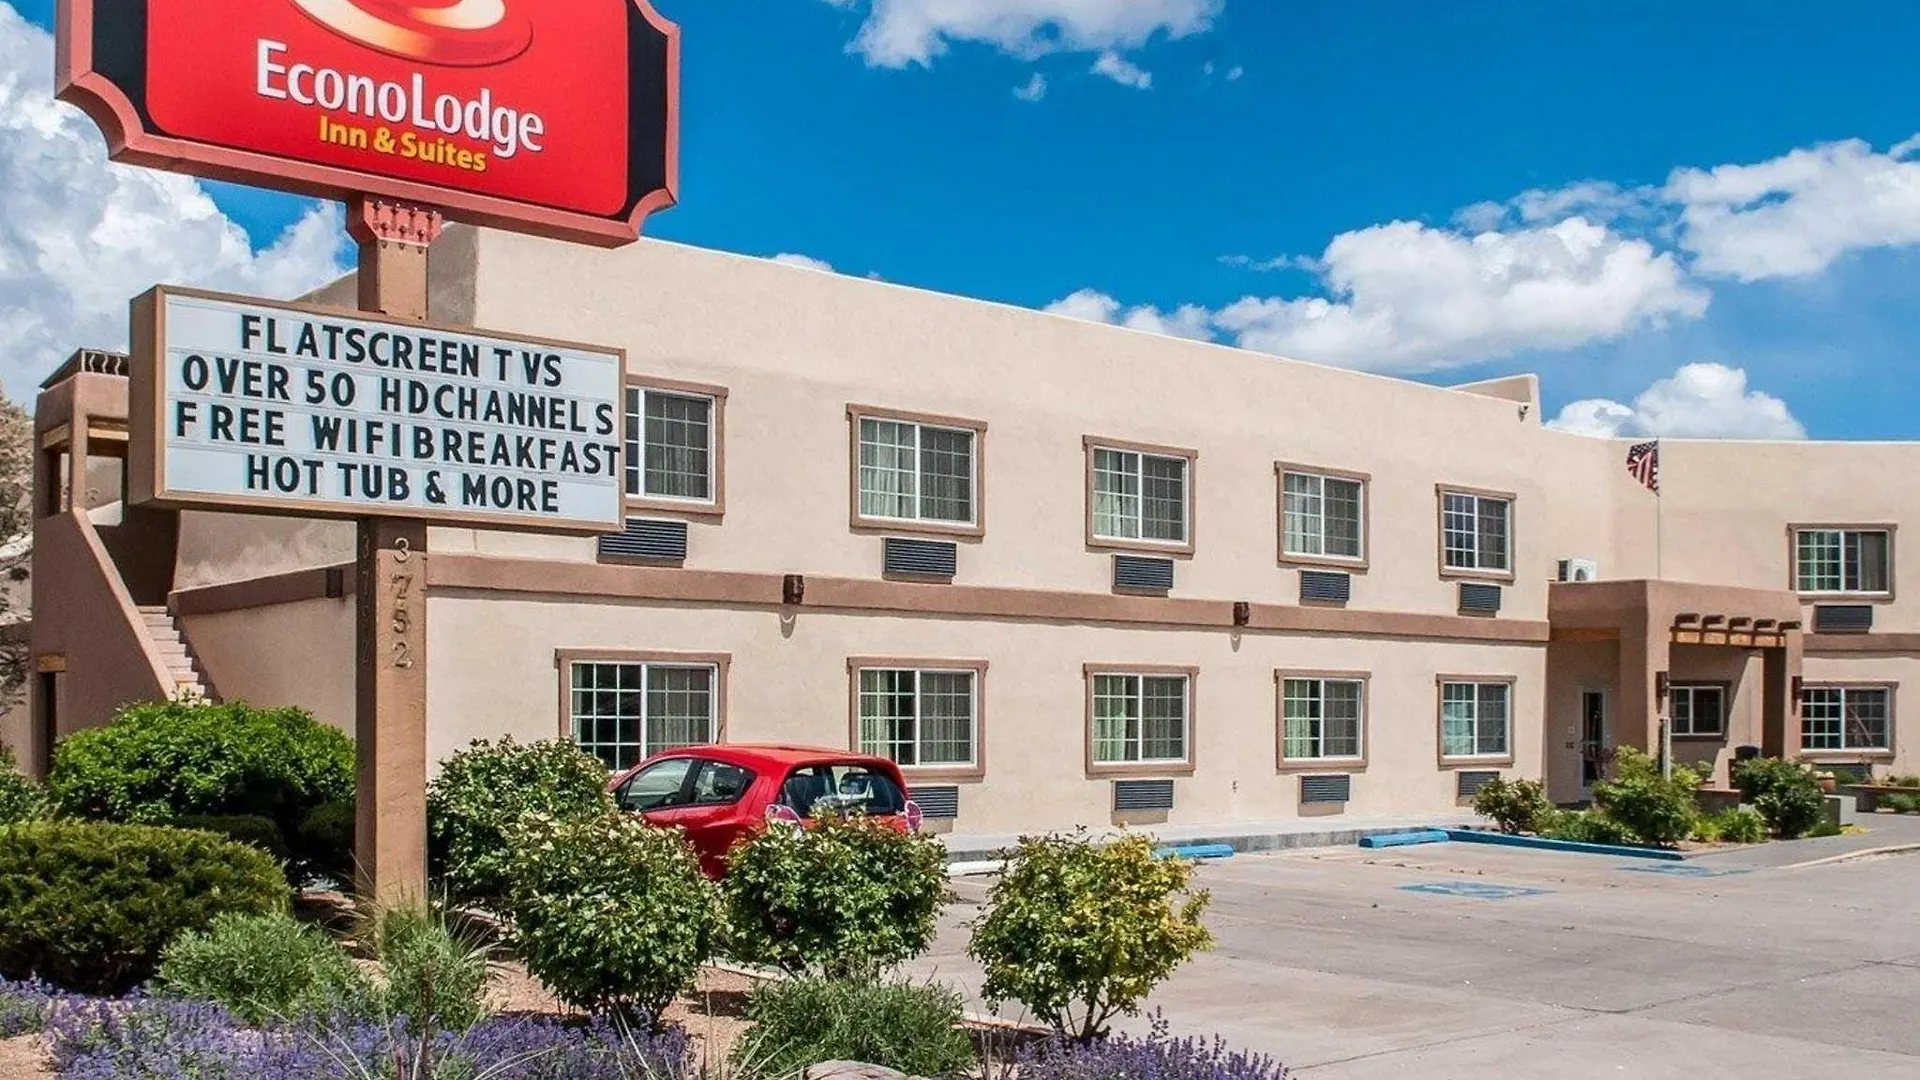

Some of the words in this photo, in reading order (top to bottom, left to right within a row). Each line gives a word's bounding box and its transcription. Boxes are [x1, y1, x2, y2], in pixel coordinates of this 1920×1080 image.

[257, 38, 544, 158] EconoLodge
[319, 115, 368, 149] Inn
[373, 127, 396, 154] &
[400, 131, 488, 172] Suites
[242, 314, 479, 378] FLATSCREEN
[182, 355, 290, 401] OVER
[305, 369, 356, 407] 50
[176, 401, 285, 446] FREE
[248, 454, 324, 495] HOT
[337, 462, 410, 501] TUB
[424, 470, 447, 505] &
[462, 473, 559, 513] MORE
[391, 536, 414, 669] 3752
